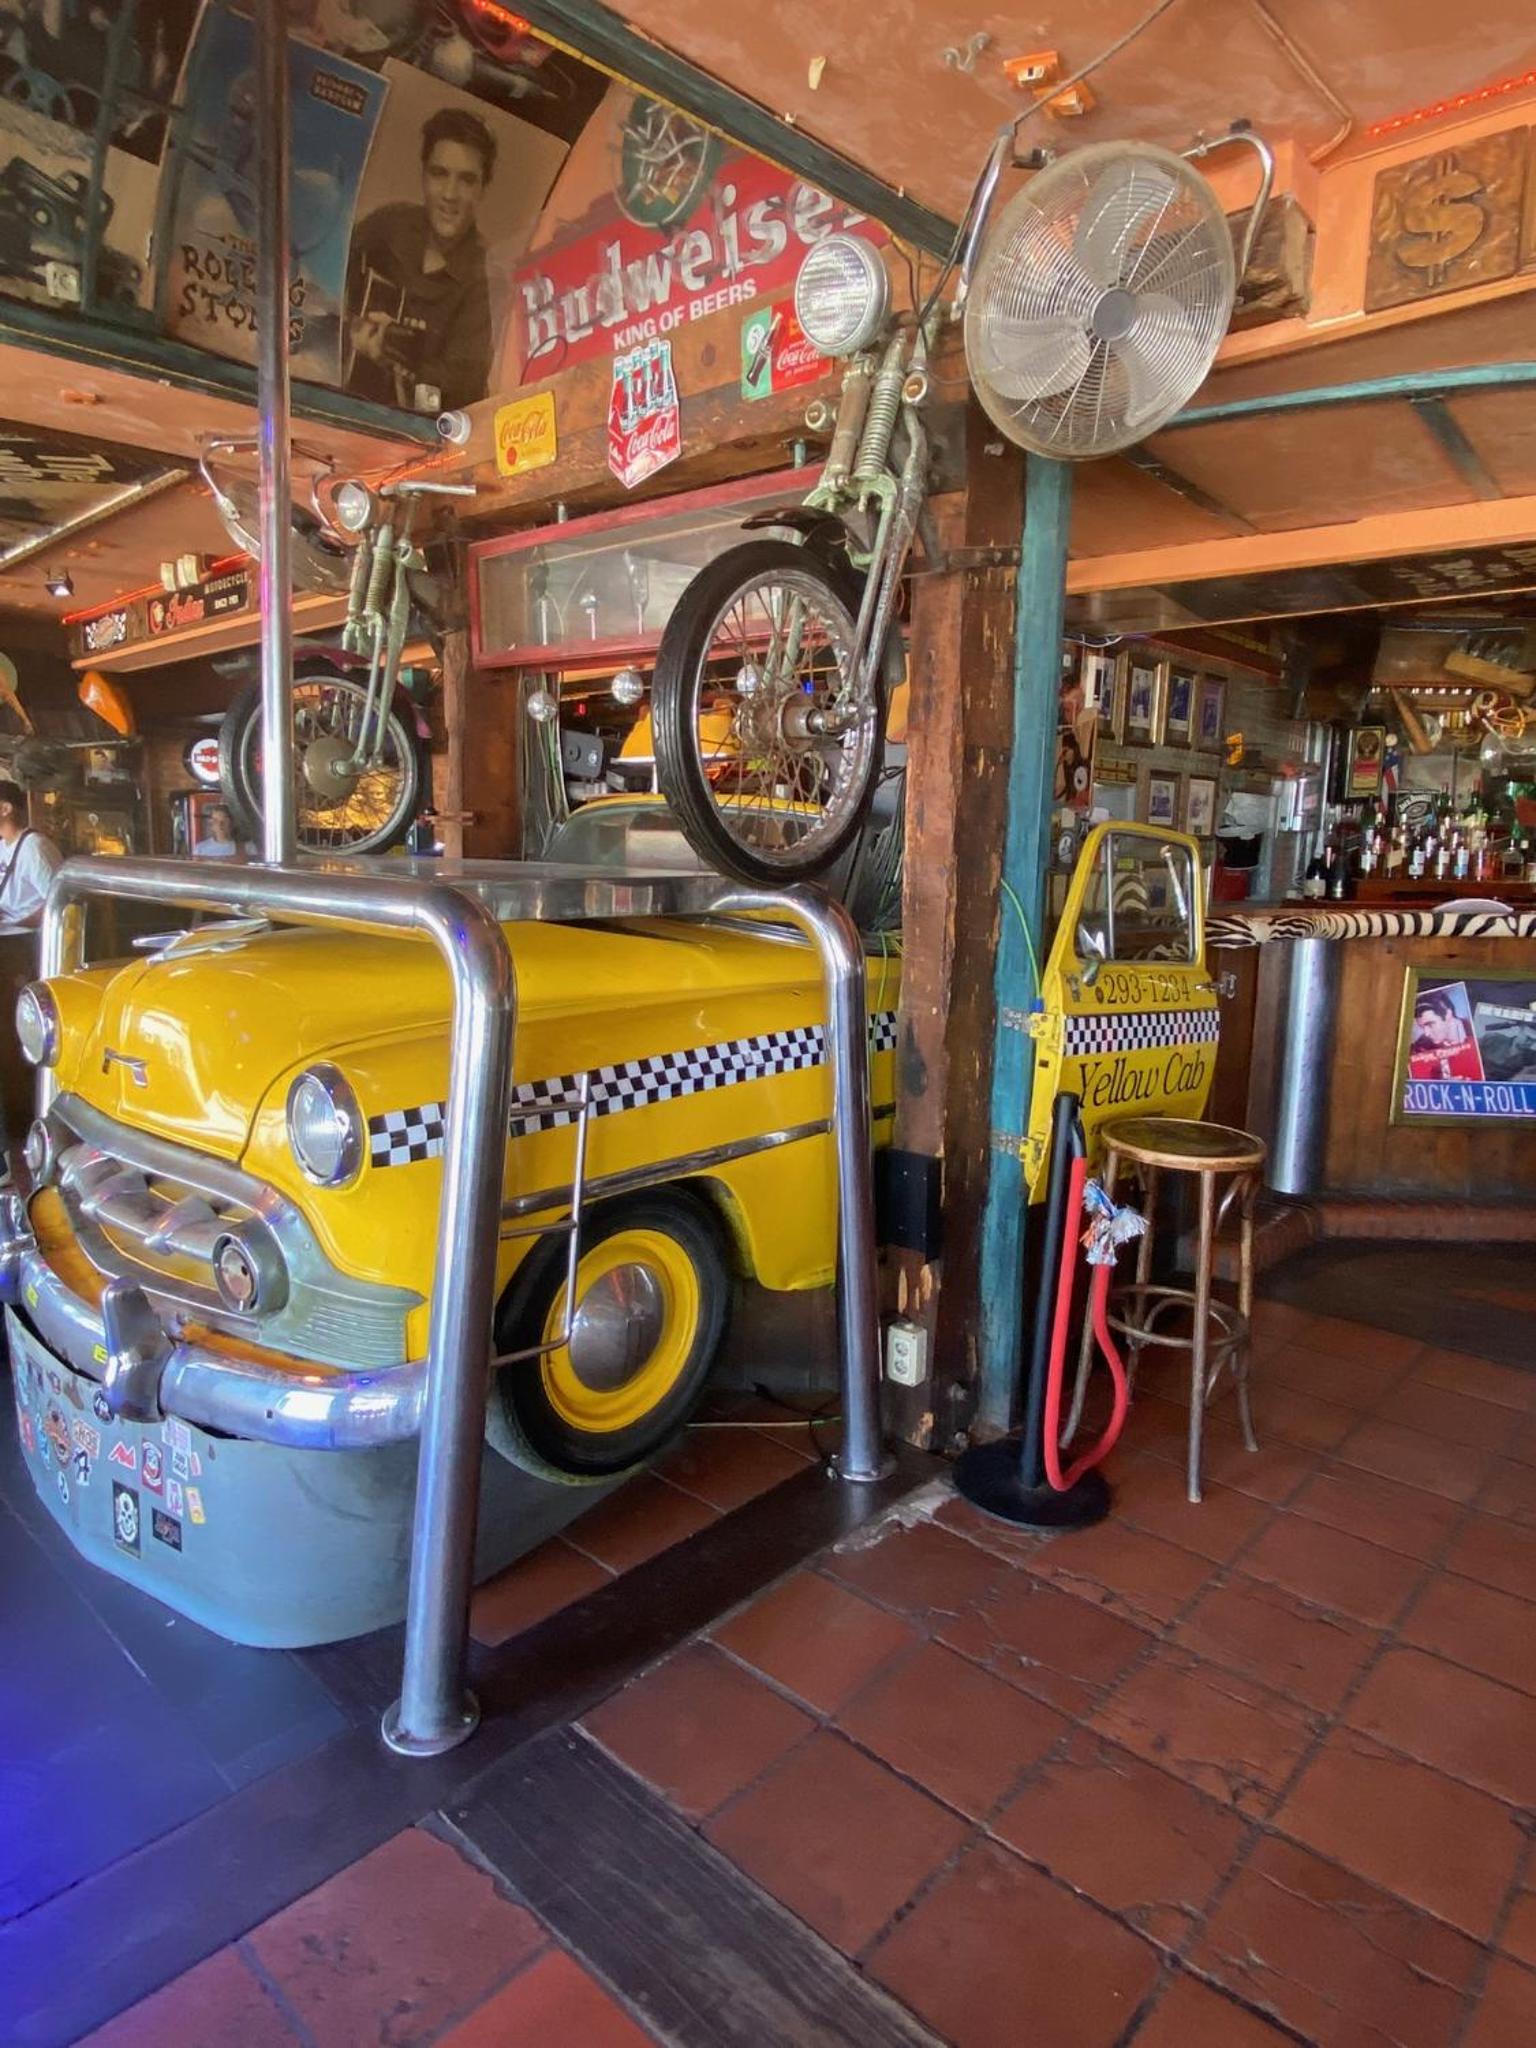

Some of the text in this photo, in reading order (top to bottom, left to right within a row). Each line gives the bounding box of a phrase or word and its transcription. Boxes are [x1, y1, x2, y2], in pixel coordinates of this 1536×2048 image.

[180, 244, 306, 308] ROLLG
[178, 283, 305, 355] STOS
[612, 278, 758, 351] KING OF BEERS
[626, 409, 677, 463] Coca-Cola
[1104, 973, 1192, 1004] 293-1234
[1079, 1050, 1206, 1109] Yellow Cab
[1403, 1082, 1535, 1114] ROCK-N-ROLL
